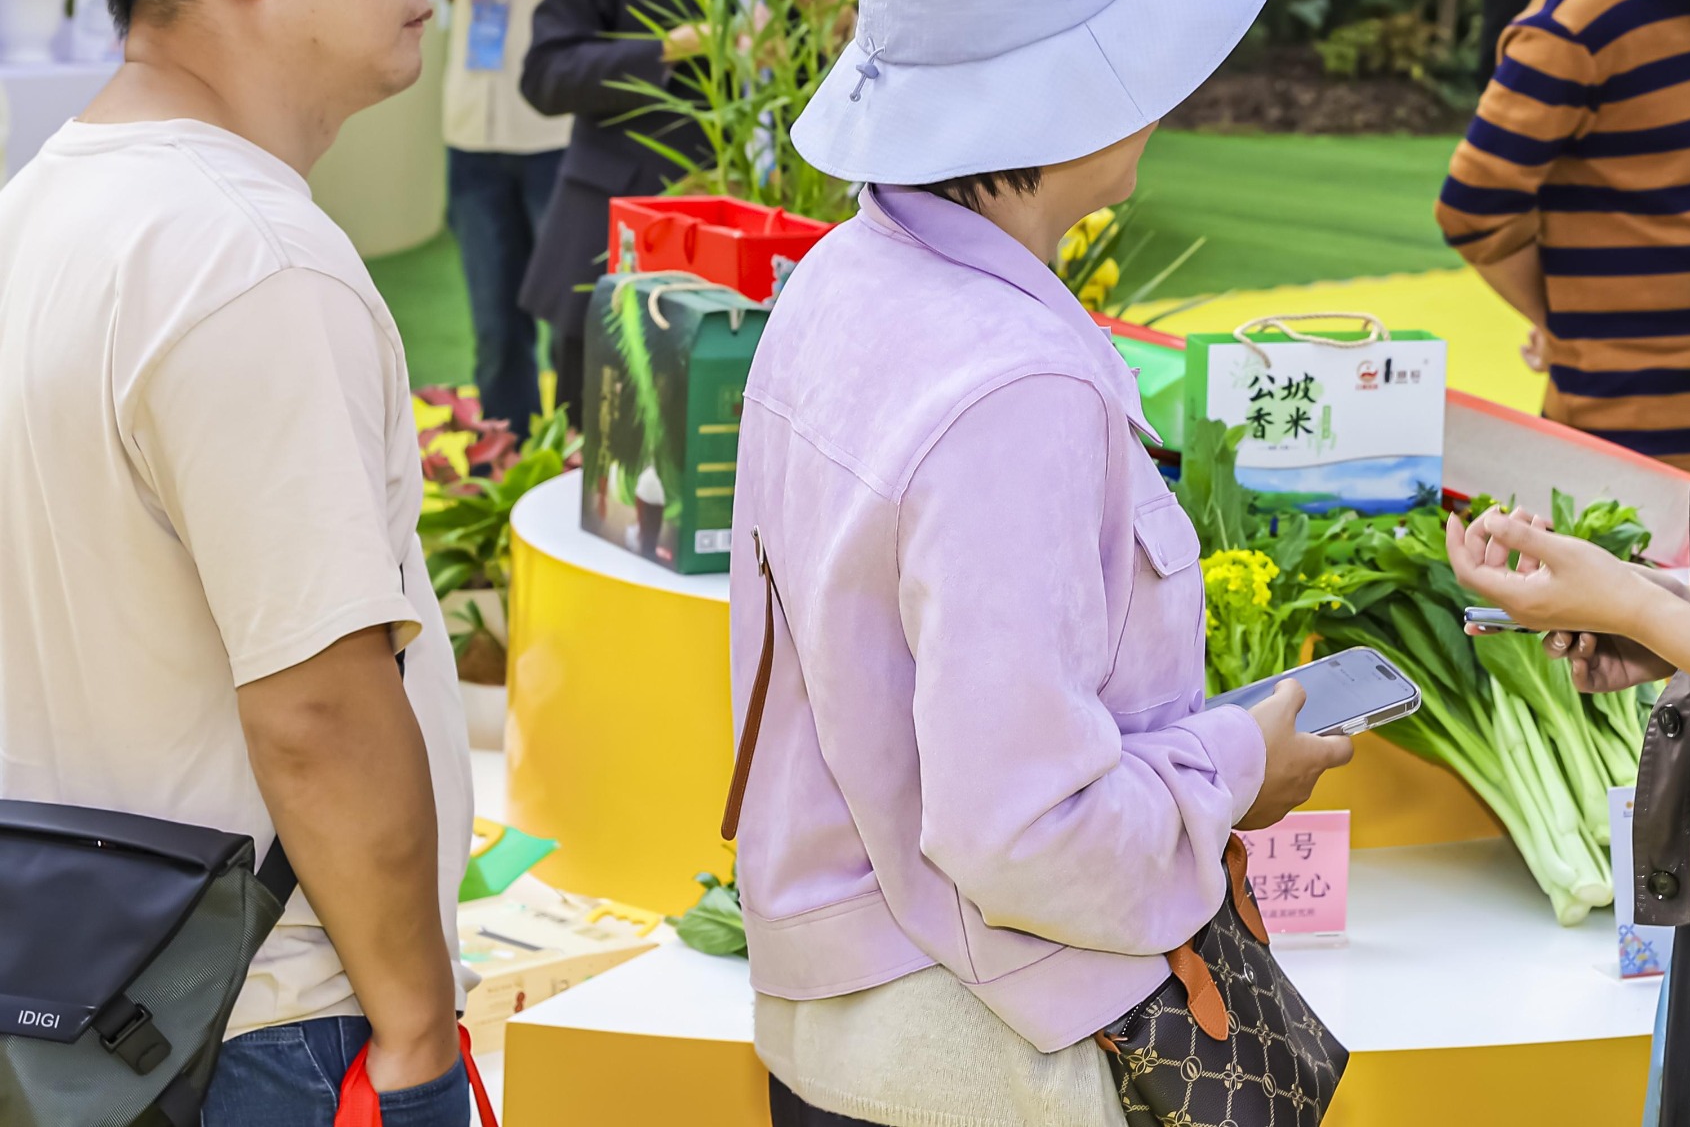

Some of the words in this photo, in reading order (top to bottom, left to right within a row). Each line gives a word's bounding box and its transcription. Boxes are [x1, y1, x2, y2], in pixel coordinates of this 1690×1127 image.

[1249, 371, 1317, 404] 公坡
[1246, 405, 1314, 440] 香米
[17, 1009, 61, 1029] IDIGI
